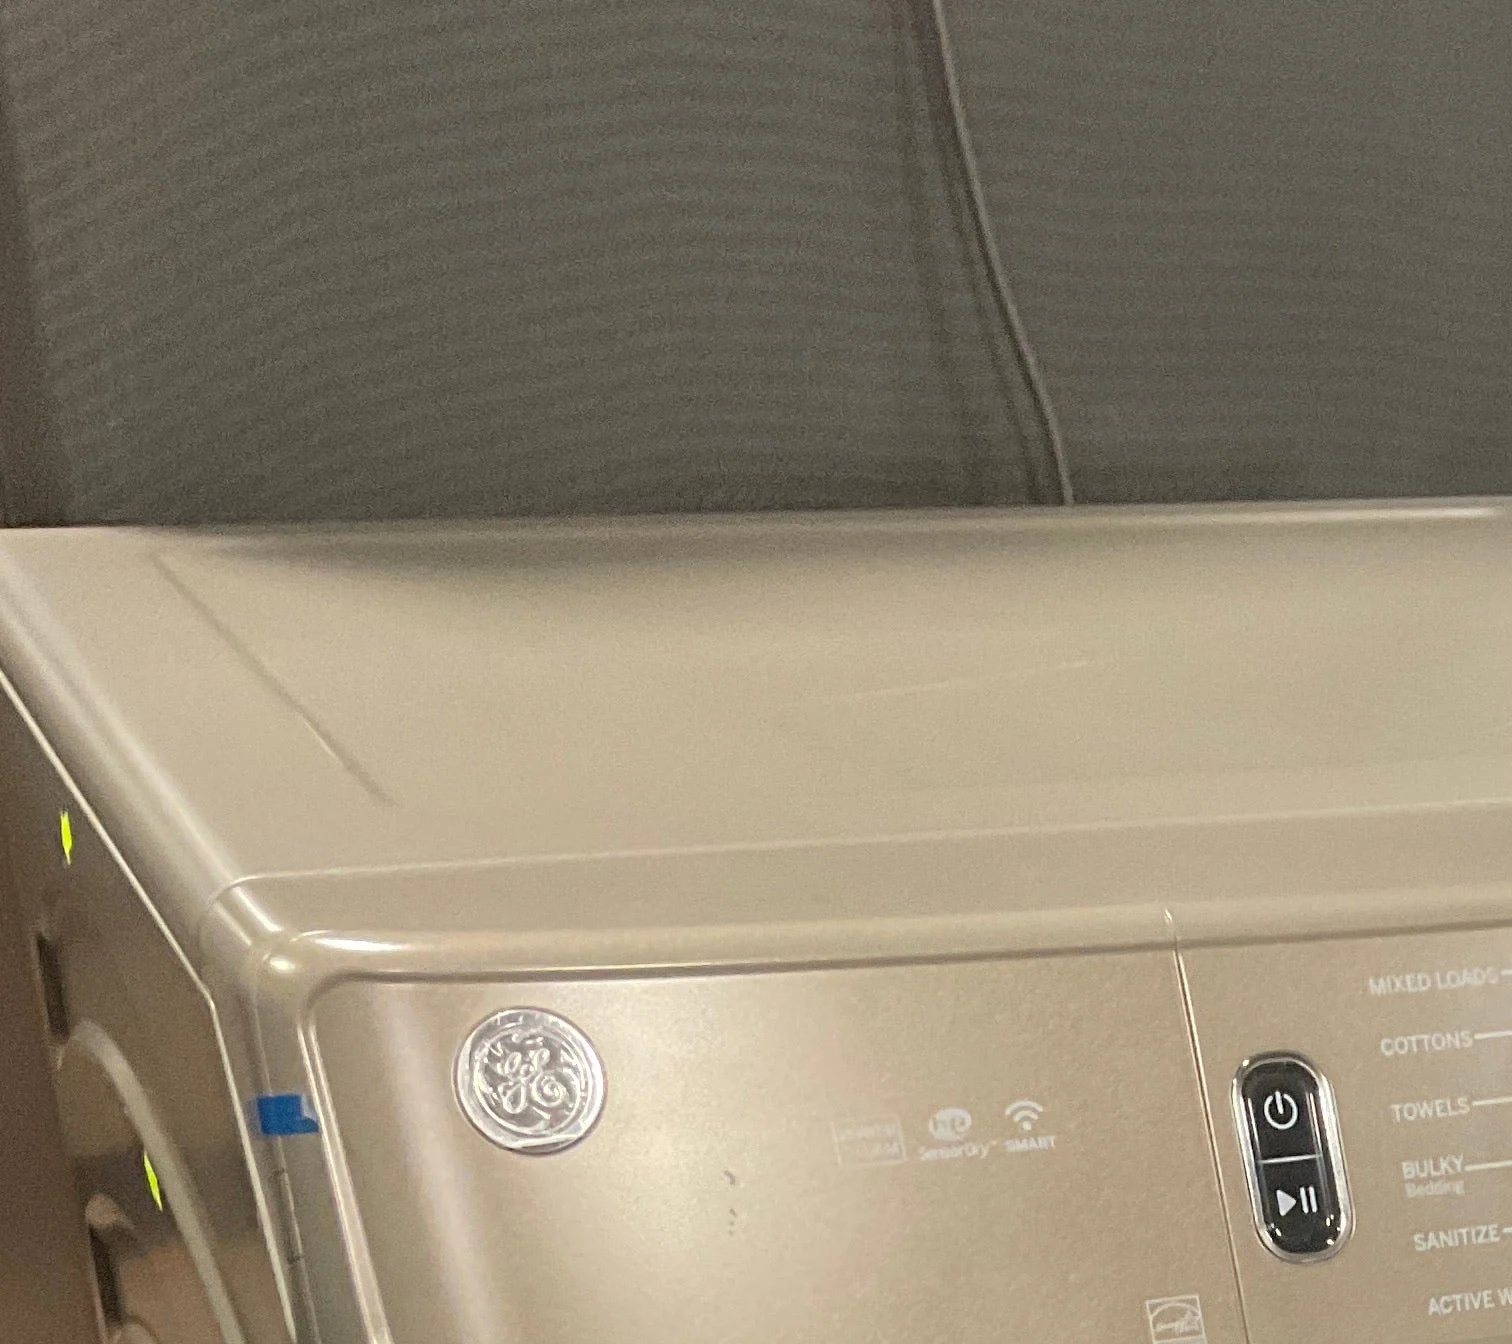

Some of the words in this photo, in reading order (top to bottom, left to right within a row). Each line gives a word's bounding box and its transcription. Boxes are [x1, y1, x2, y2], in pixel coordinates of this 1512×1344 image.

[1368, 972, 1431, 996] MIXED
[1436, 966, 1499, 990] LOADS
[1380, 1030, 1474, 1056] COTTONS
[1390, 1096, 1471, 1122] TOWELS
[1005, 1135, 1056, 1153] SMART
[1402, 1153, 1464, 1179] BULKY
[1413, 1223, 1500, 1251] SANITIZE
[1428, 1290, 1495, 1316] ACTIVE
